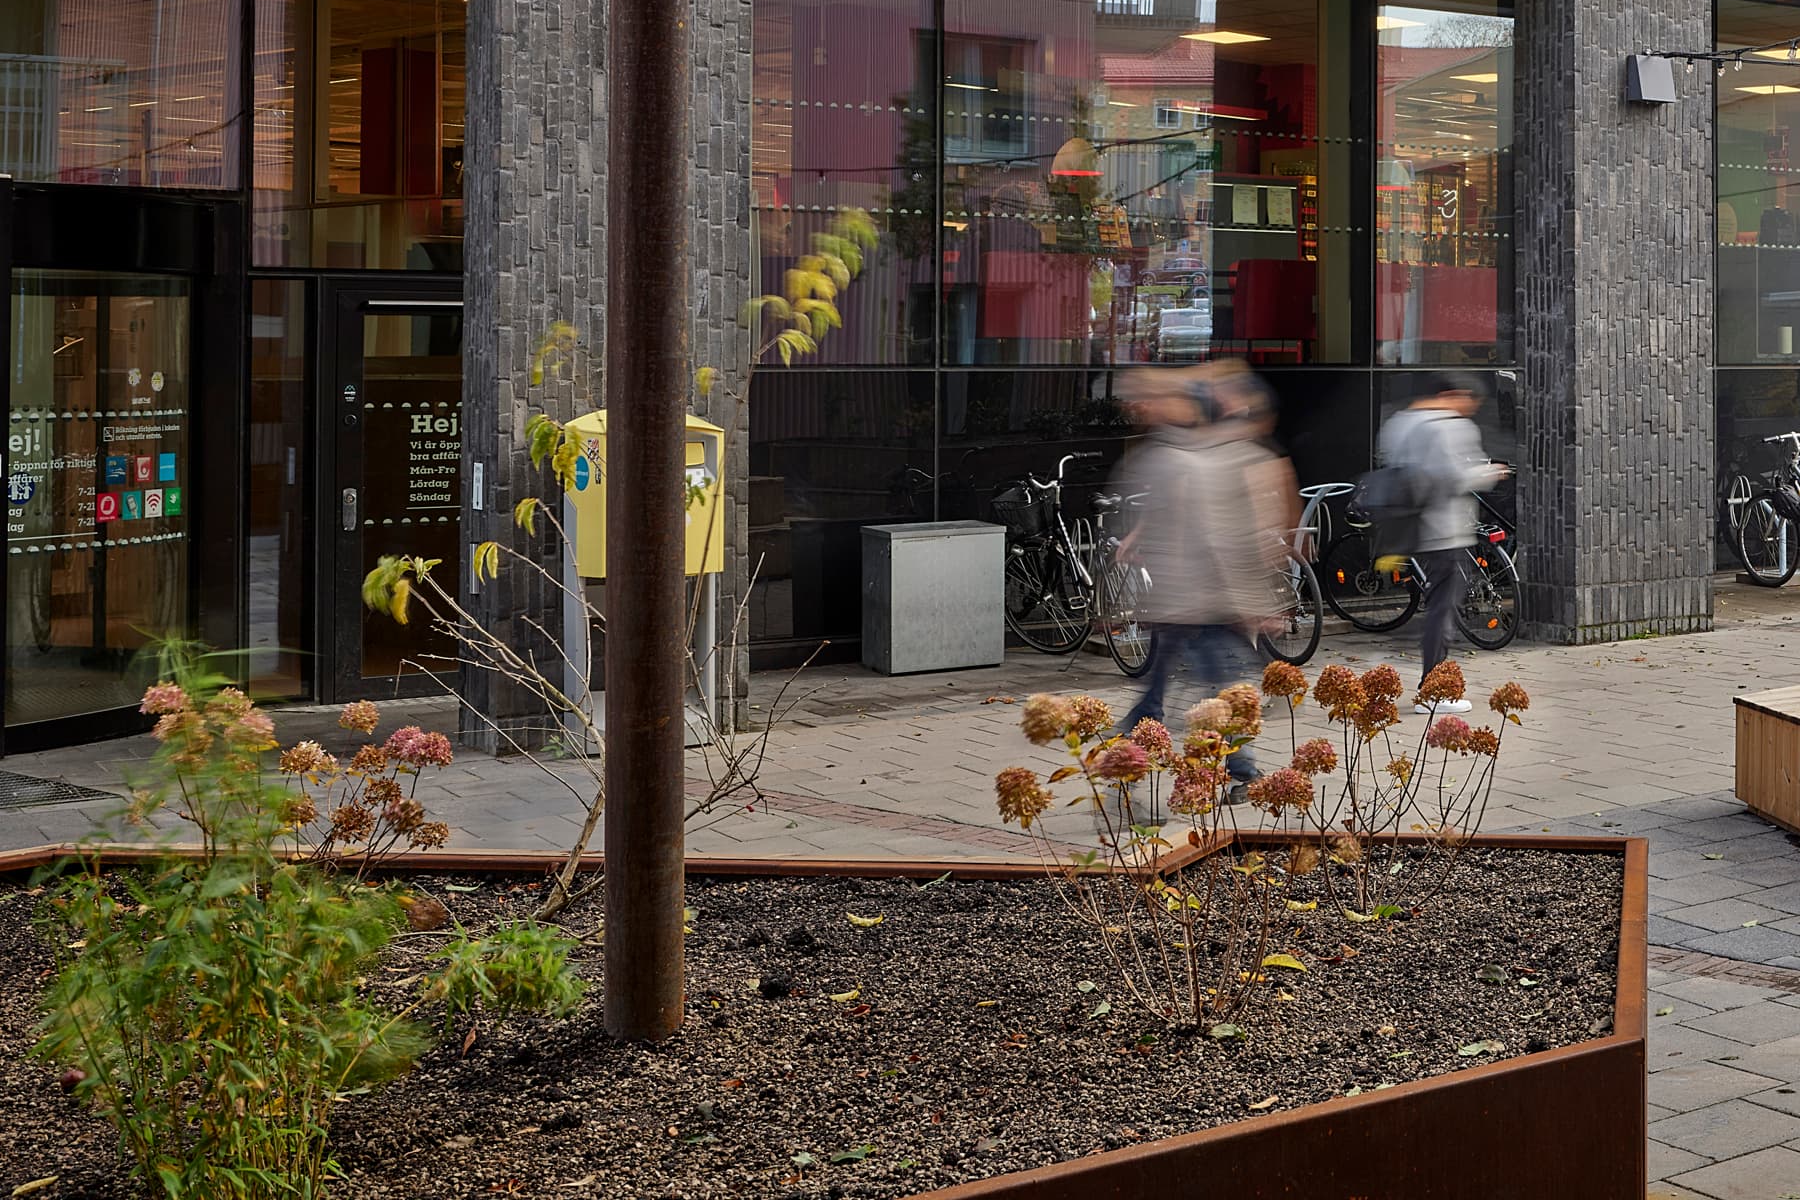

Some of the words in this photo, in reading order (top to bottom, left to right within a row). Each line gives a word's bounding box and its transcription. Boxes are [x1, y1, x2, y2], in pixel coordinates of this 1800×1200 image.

[410, 441, 422, 450] Vi
[424, 440, 438, 450] är
[439, 440, 462, 452] öpp
[410, 452, 430, 461] bra
[13, 461, 48, 472] öppna
[409, 466, 456, 475] Mån-Fre
[409, 480, 450, 489] Lördag
[409, 492, 452, 502] Söndag
